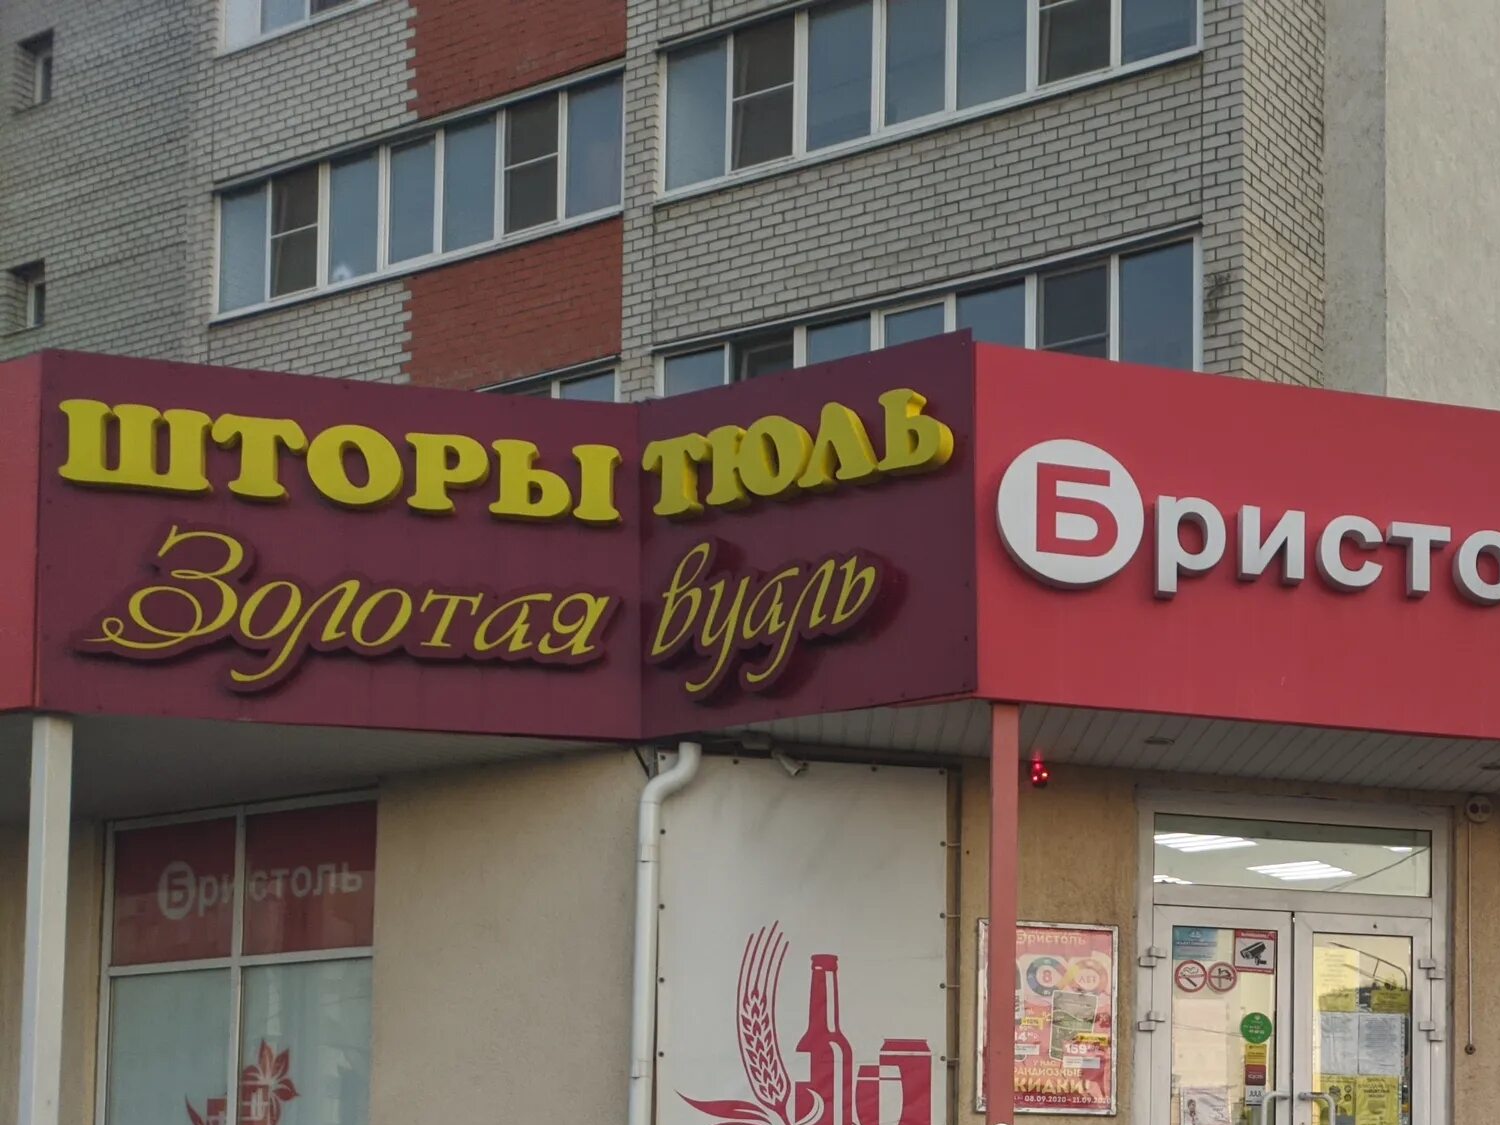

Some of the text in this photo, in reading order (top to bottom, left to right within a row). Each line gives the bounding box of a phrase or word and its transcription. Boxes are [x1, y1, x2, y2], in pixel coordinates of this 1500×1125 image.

[58, 387, 954, 525] ШТОРЫ ТЮЛЬ
[83, 525, 878, 696] Золотая вуаль
[1014, 1067, 1082, 1077] РАНДИОЗНЫЕ
[1014, 1077, 1090, 1094] КИДКИ!
